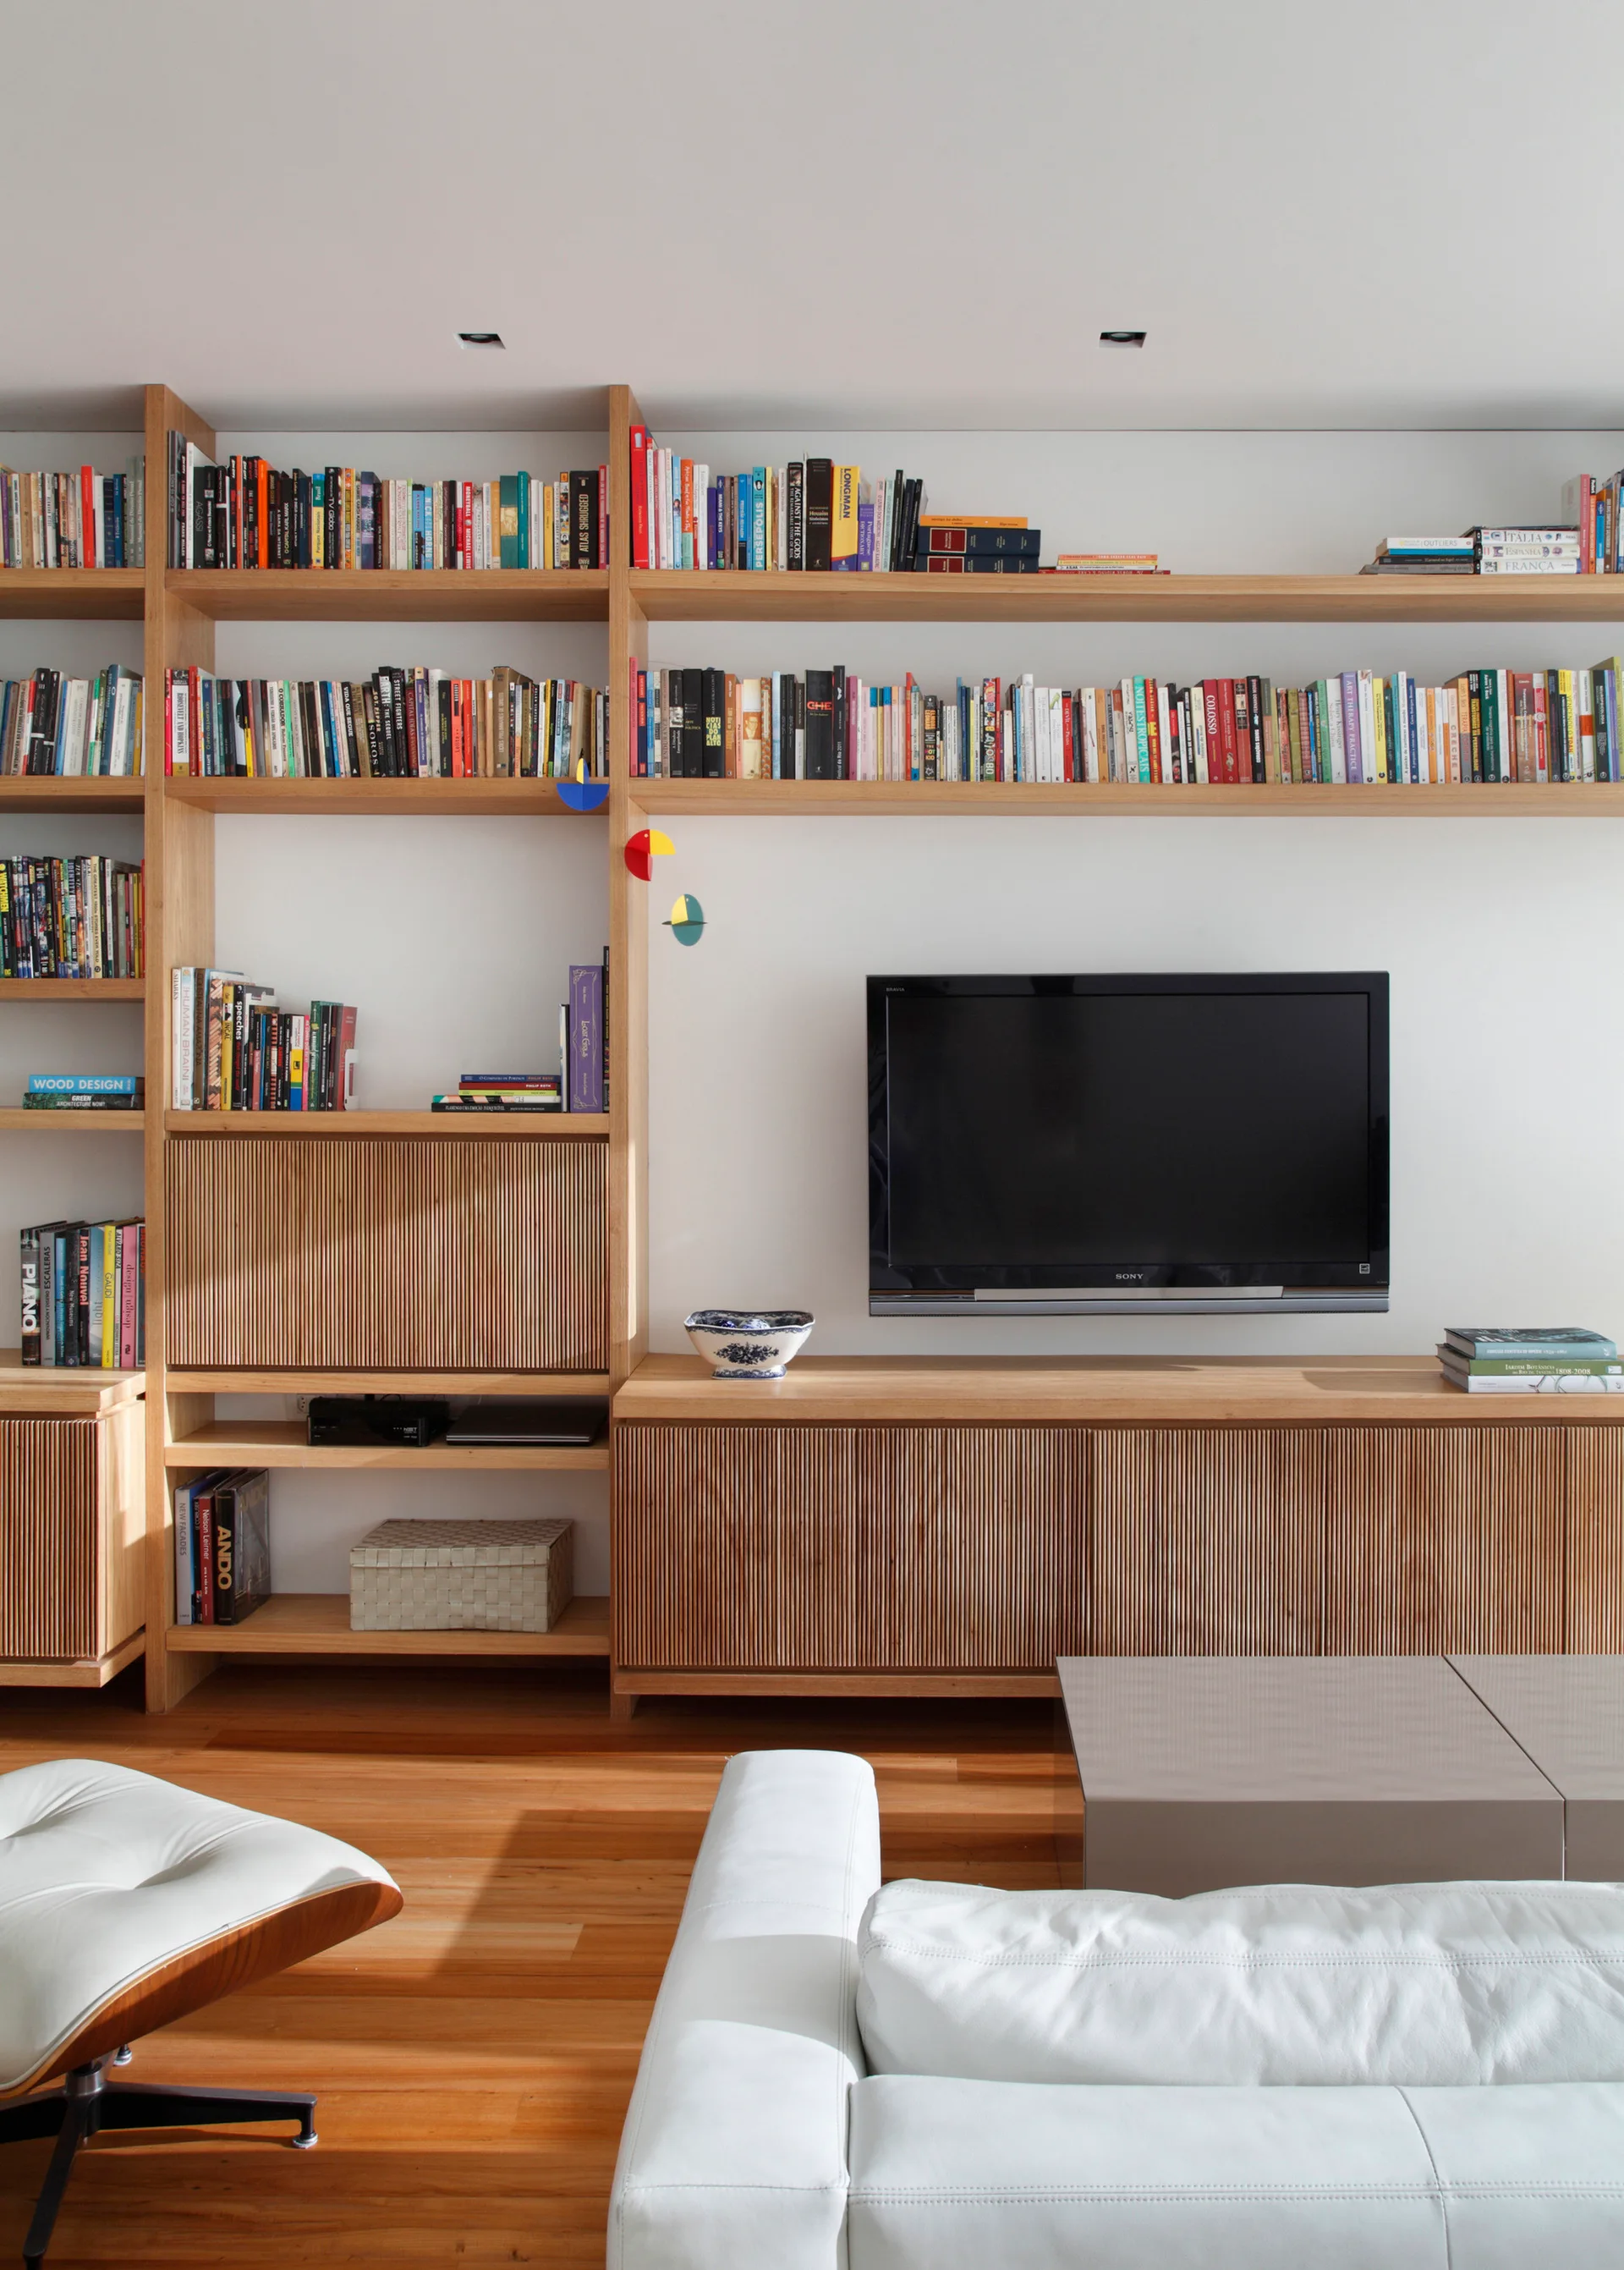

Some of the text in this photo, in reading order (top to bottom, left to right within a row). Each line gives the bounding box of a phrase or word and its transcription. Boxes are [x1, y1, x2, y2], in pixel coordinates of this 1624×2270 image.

[328, 497, 335, 508] TV
[843, 468, 852, 519] LONGMAN
[195, 501, 204, 532] AGASSI
[579, 493, 589, 552] ATLAS SHRUGGED
[754, 502, 764, 568] PERSEPOLIS
[1503, 530, 1543, 542] ITÁLIA
[1505, 547, 1542, 556] ESPANHA
[1505, 561, 1555, 572] FRANÇA
[807, 701, 832, 711] CHE
[1206, 695, 1217, 734] COLOSSO
[1347, 697, 1355, 732] THERAPY
[177, 731, 185, 754] HOPKINS
[368, 724, 379, 761] SOROS
[1335, 720, 1343, 750] Kissinger
[1349, 734, 1358, 770] PRACTICE
[182, 988, 190, 1037] HUMAN
[234, 1000, 244, 1040] speeches
[581, 1020, 590, 1036] Lost
[33, 1079, 123, 1090] WOOD DESIGN
[80, 1234, 90, 1305] Jean Nouvel
[123, 1264, 134, 1293] design
[22, 1263, 36, 1333] PIANO
[104, 1272, 114, 1299] GAUDÍ
[122, 1299, 134, 1329] design
[202, 1535, 211, 1560] Leirner
[217, 1525, 233, 1591] ANDO
